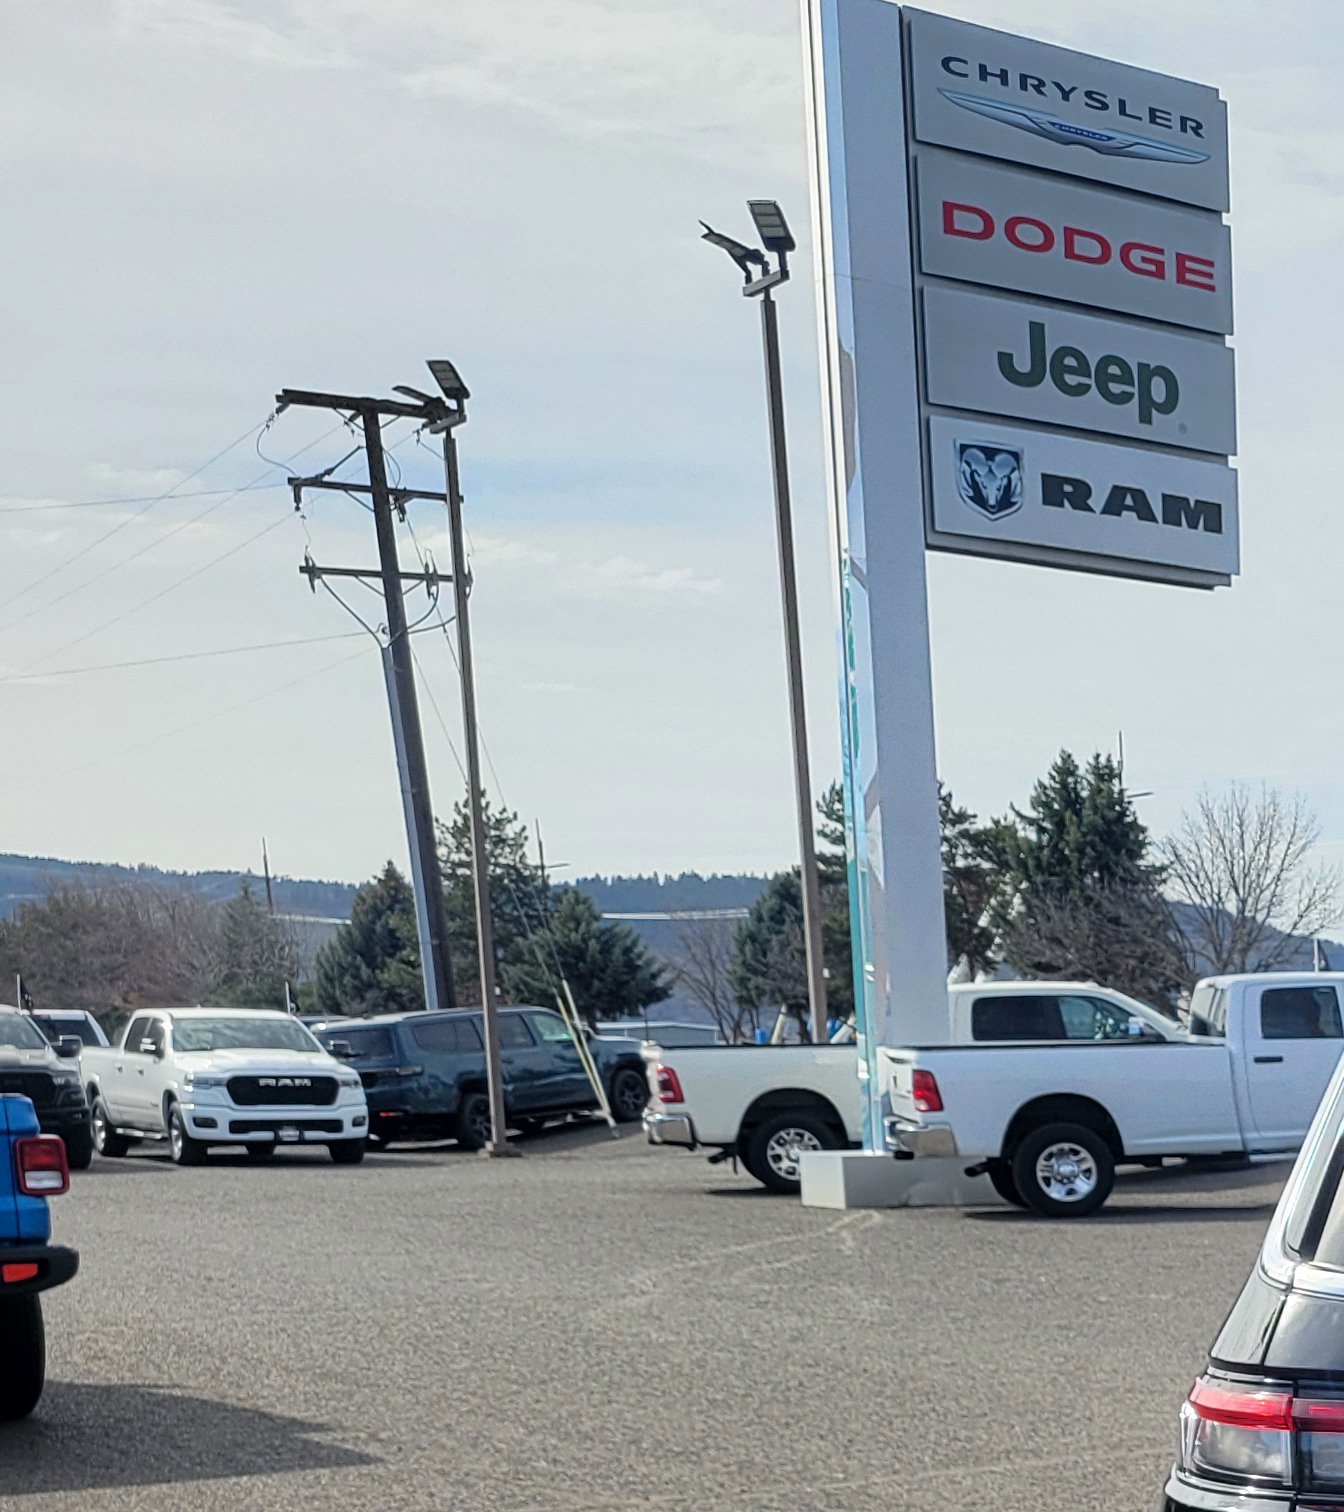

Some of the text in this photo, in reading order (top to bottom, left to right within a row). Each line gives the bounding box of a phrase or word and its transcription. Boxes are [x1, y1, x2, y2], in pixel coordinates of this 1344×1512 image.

[940, 56, 1205, 139] CHRYSLER
[942, 201, 1216, 292] DODGE
[997, 321, 1179, 424] Jeep
[1040, 473, 1223, 535] RAM
[259, 1078, 311, 1087] RAM
